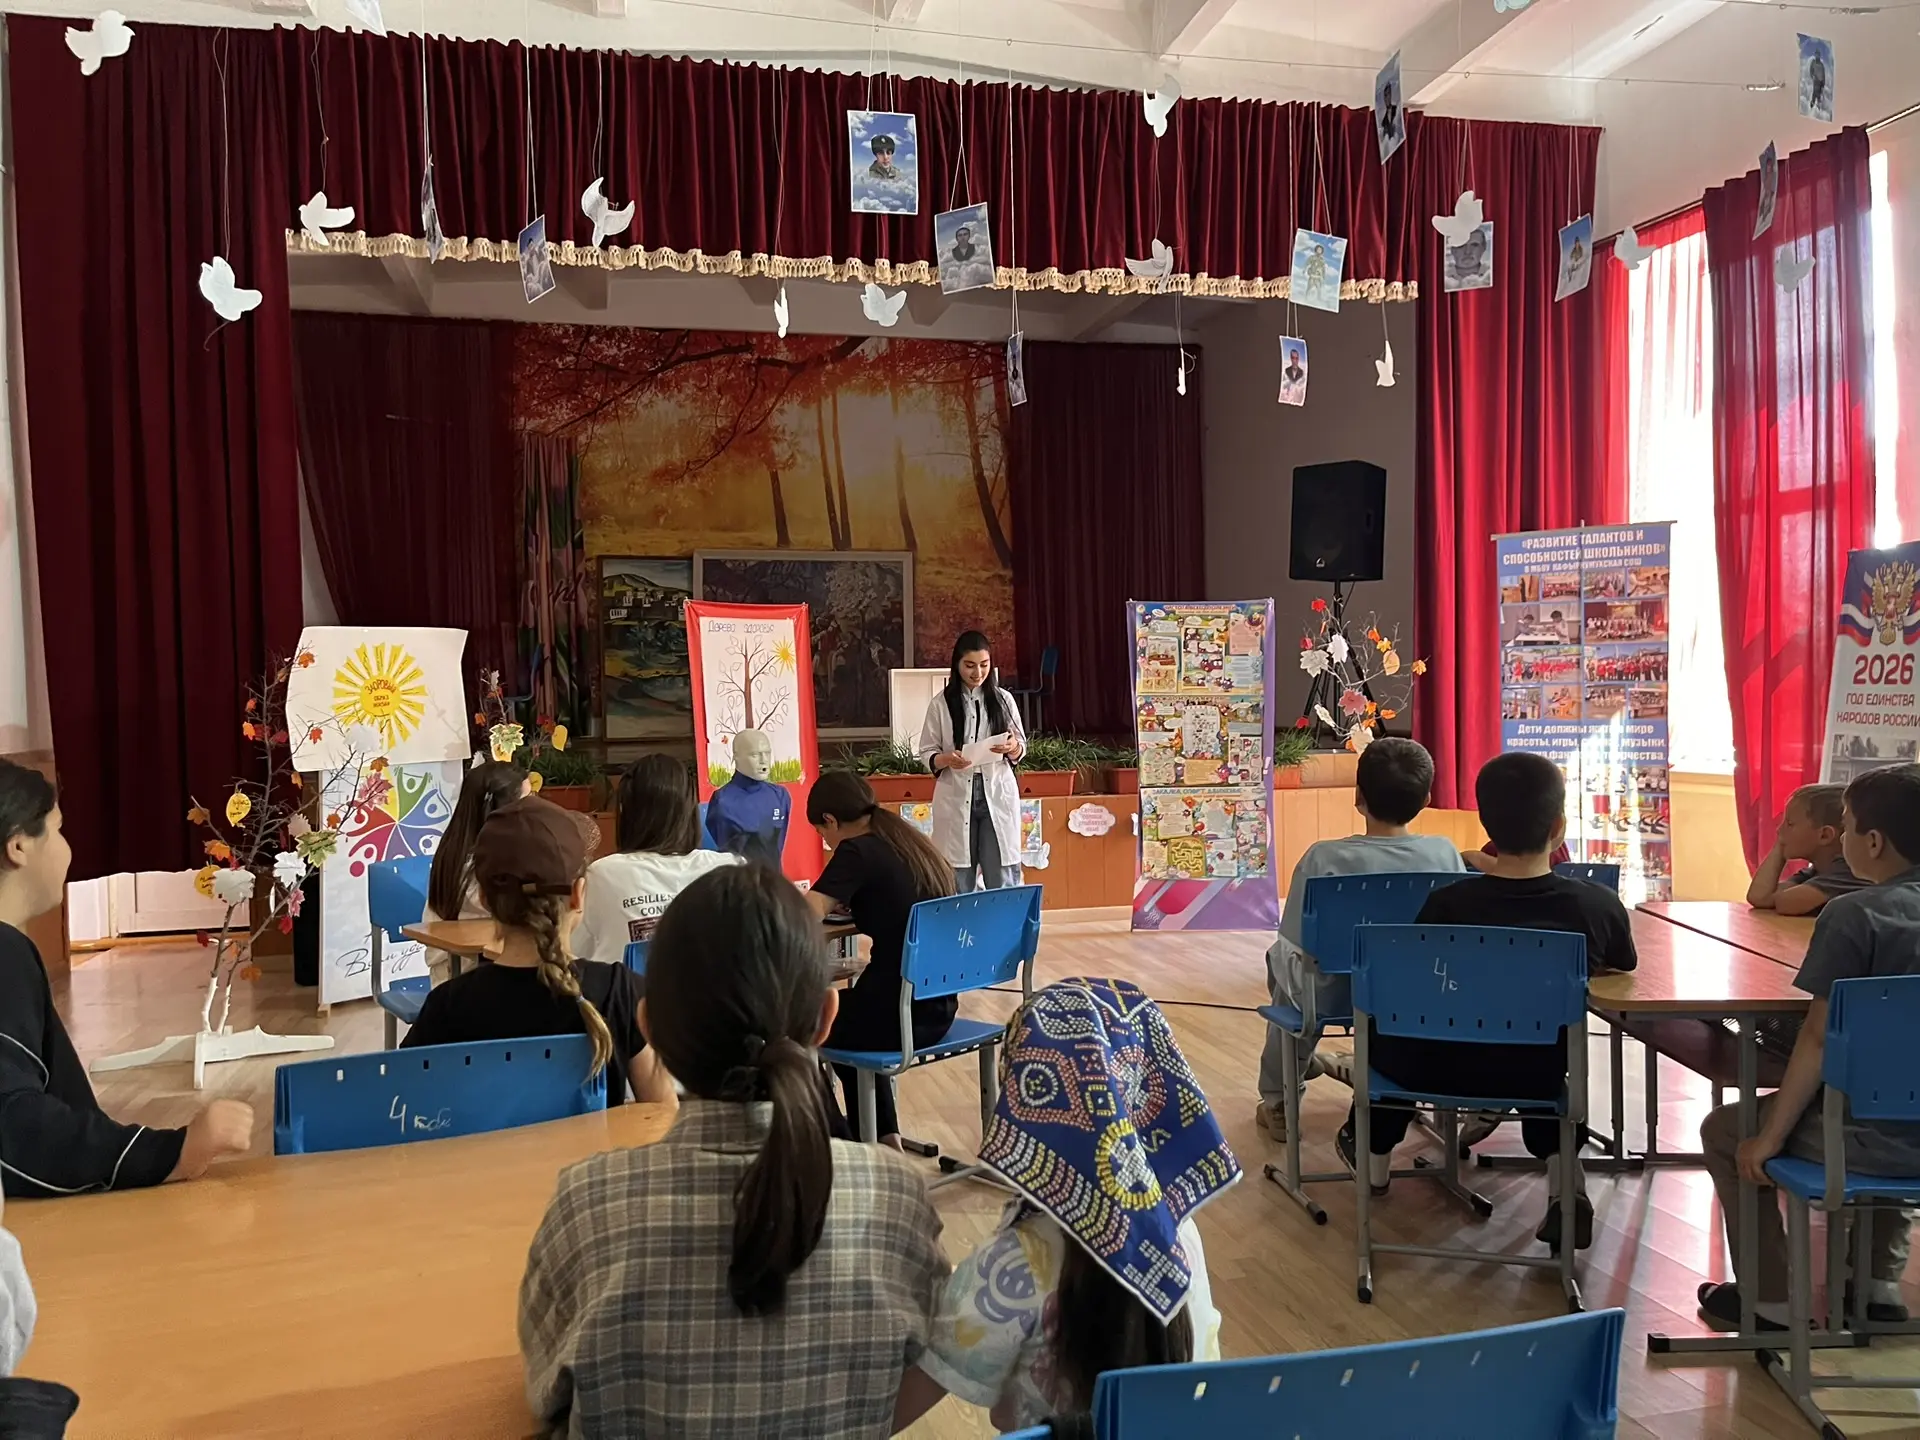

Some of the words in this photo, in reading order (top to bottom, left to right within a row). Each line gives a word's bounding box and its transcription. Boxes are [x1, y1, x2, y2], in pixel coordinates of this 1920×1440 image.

[1581, 531, 1634, 545] ТАЛАНТОВ
[1636, 529, 1644, 541] И
[1503, 547, 1581, 565] СПОСОБНОСТЕЙ
[1853, 653, 1915, 685] 2026
[1845, 693, 1864, 705] ГОД
[1866, 693, 1915, 707] ЕДИНСТВА
[1836, 711, 1880, 725] НАРОДОВ
[1882, 713, 1920, 728] РОССИИ
[1518, 724, 1542, 735] Дети
[1543, 725, 1587, 734] должны
[1626, 724, 1654, 734] мире
